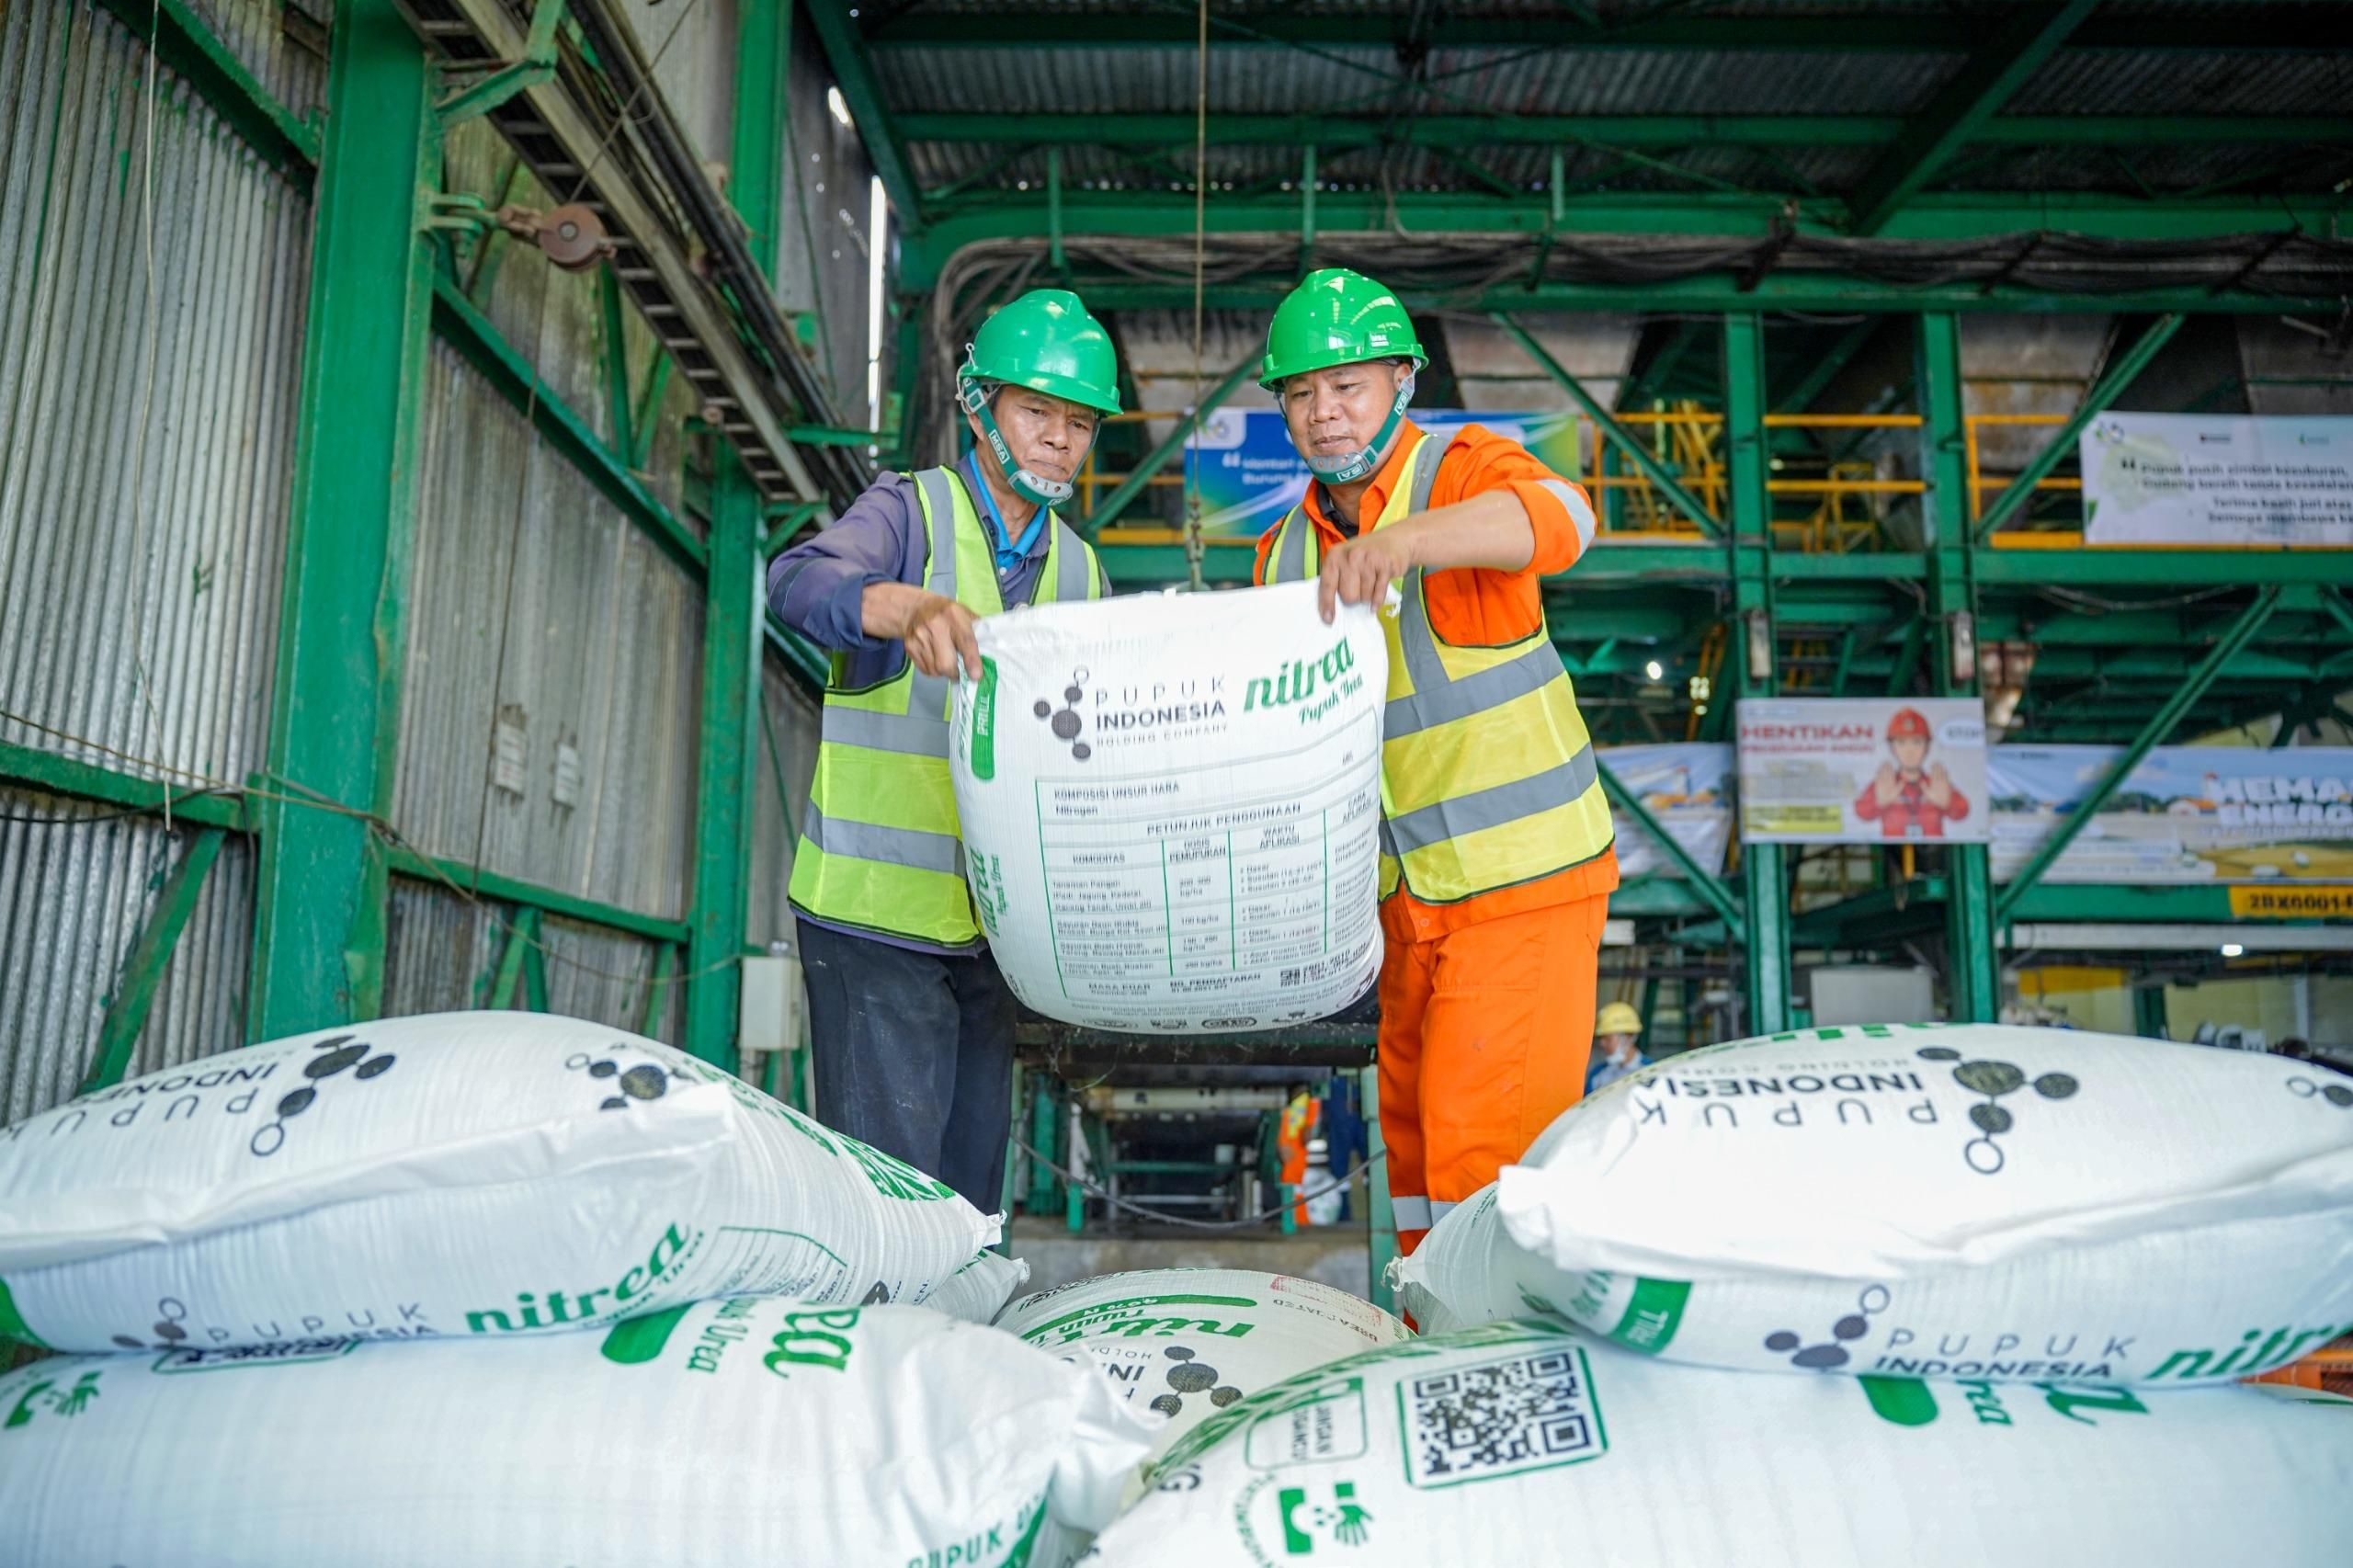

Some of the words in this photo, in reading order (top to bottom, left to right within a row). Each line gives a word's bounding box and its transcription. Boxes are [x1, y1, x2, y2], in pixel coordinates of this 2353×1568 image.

[991, 434, 1007, 461] MSA
[1243, 636, 1355, 712] nitrea
[1096, 677, 1225, 705] PUPUK
[1096, 699, 1226, 731] INDONESIA
[1054, 788, 1109, 801] KOMPOSISI
[1112, 785, 1147, 799] UNSUR
[1151, 781, 1179, 795] HARA
[2208, 777, 2353, 802] HEMA
[1056, 805, 1098, 817] Nitrogen
[1147, 817, 1211, 835] PETUNJUK
[1216, 801, 1301, 824] PENGGUNAAN
[1636, 1096, 1938, 1128] PUPUK
[464, 1221, 689, 1333] nitrea
[207, 1303, 427, 1342] PUPUK
[688, 1323, 749, 1374] Urea
[1091, 1346, 1153, 1359] HOLD
[1887, 1328, 2136, 1359] PUPUK
[2143, 1322, 2353, 1380] nitr
[1874, 1356, 2112, 1378] INDONESIA
